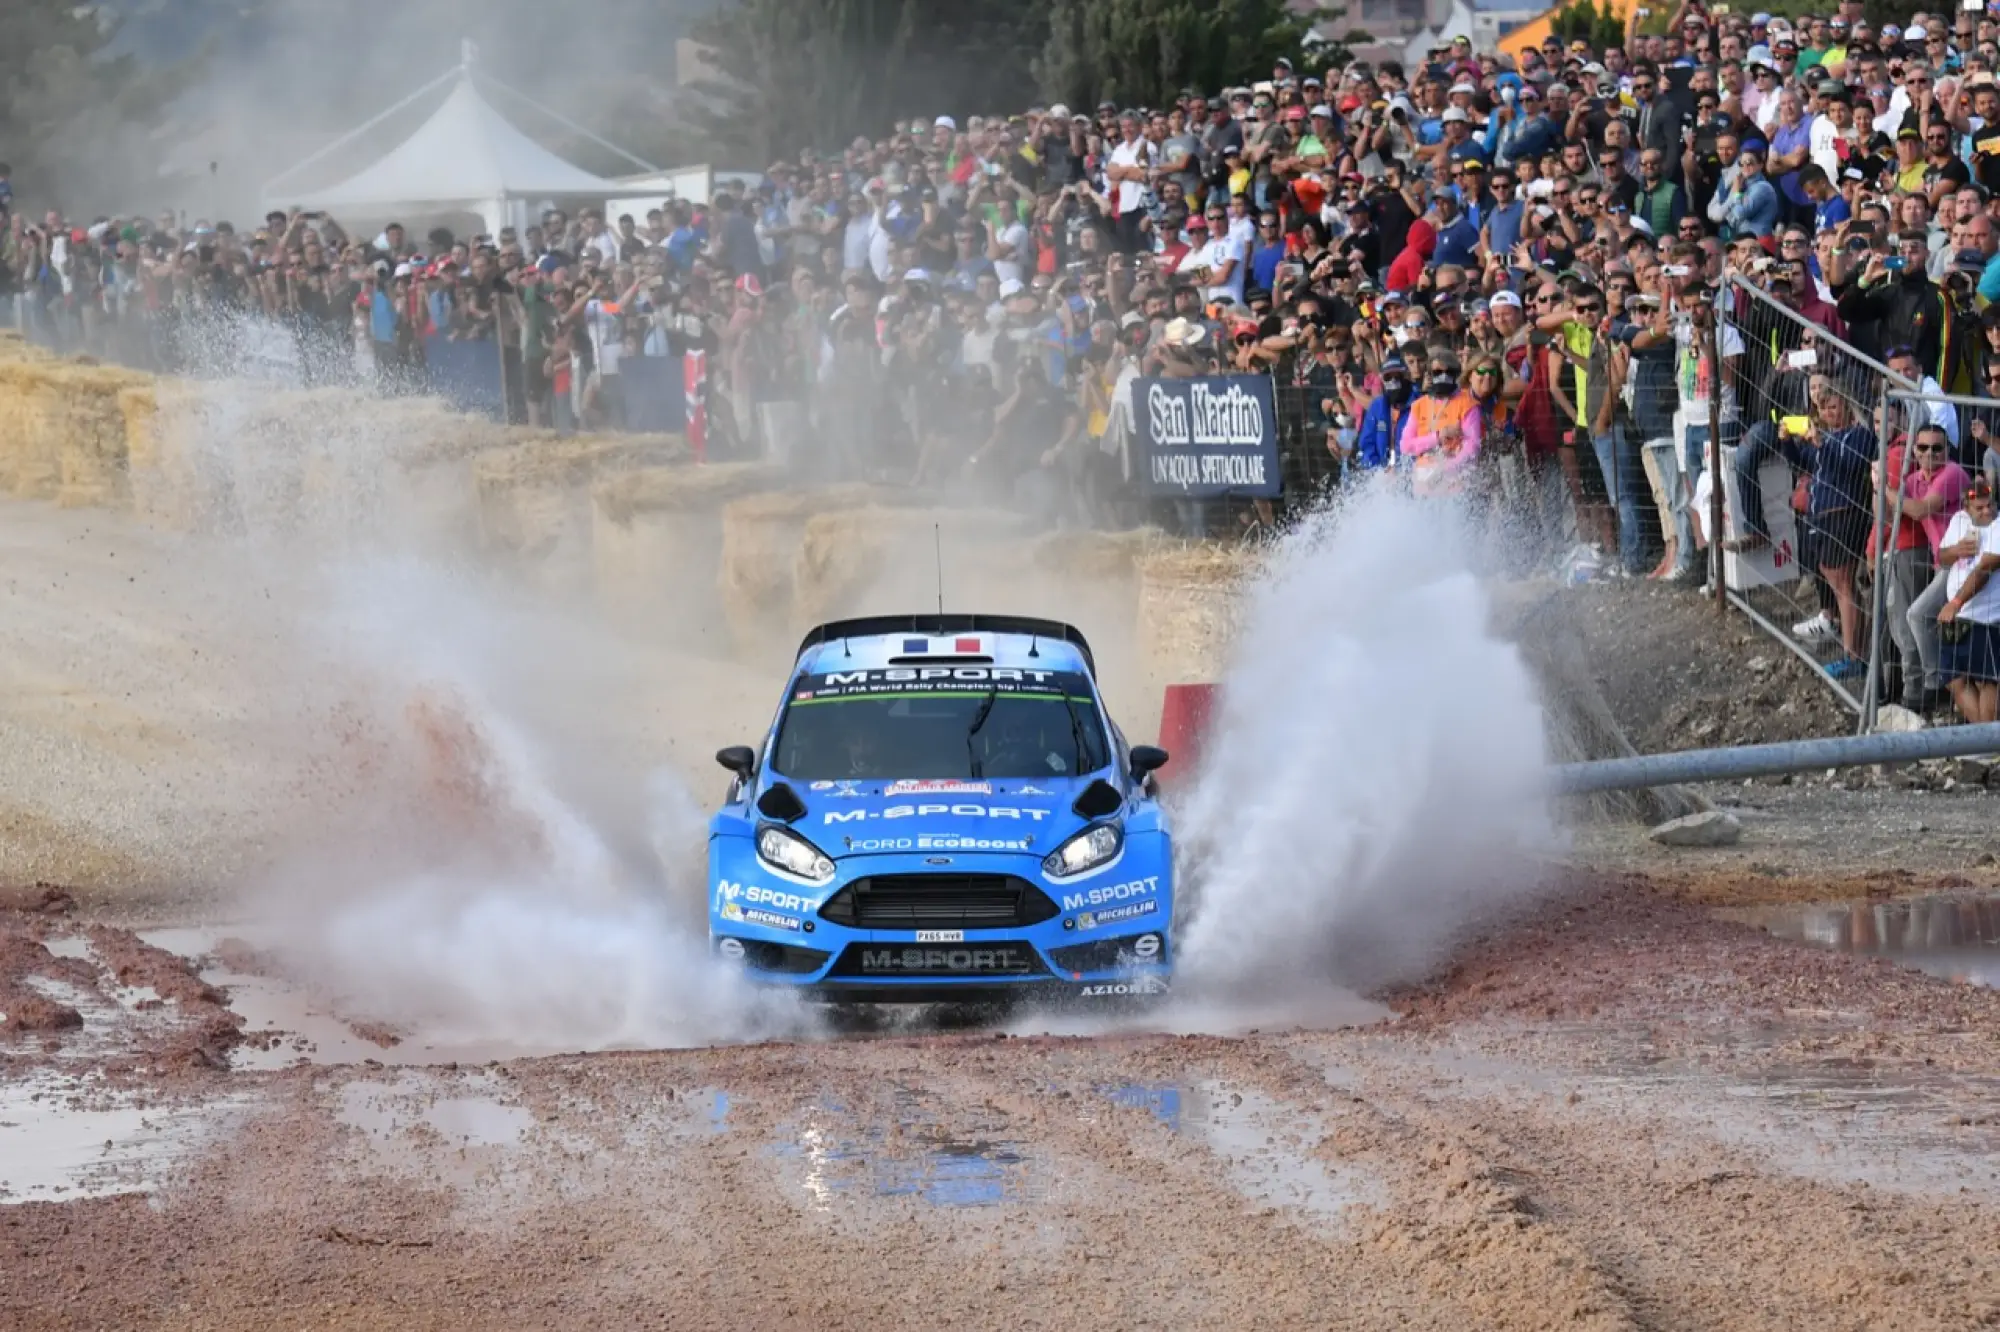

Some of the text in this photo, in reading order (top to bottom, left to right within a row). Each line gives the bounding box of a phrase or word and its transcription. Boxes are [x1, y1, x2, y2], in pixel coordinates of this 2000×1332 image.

[1148, 382, 1263, 445] San Martino
[1202, 455, 1266, 485] SPETTACOLARE
[824, 669, 1054, 686] M-SPORT
[869, 683, 902, 691] World
[905, 682, 934, 691] Rally
[824, 804, 1051, 824] M-SPORT
[850, 837, 1028, 851] FORD EcoBoost
[718, 879, 817, 913] M-SPORT
[1063, 876, 1158, 911] M-SPORT
[745, 909, 799, 929] MICHELIN
[1097, 900, 1155, 921] MICHELIN
[862, 949, 1018, 969] M-SPORT
